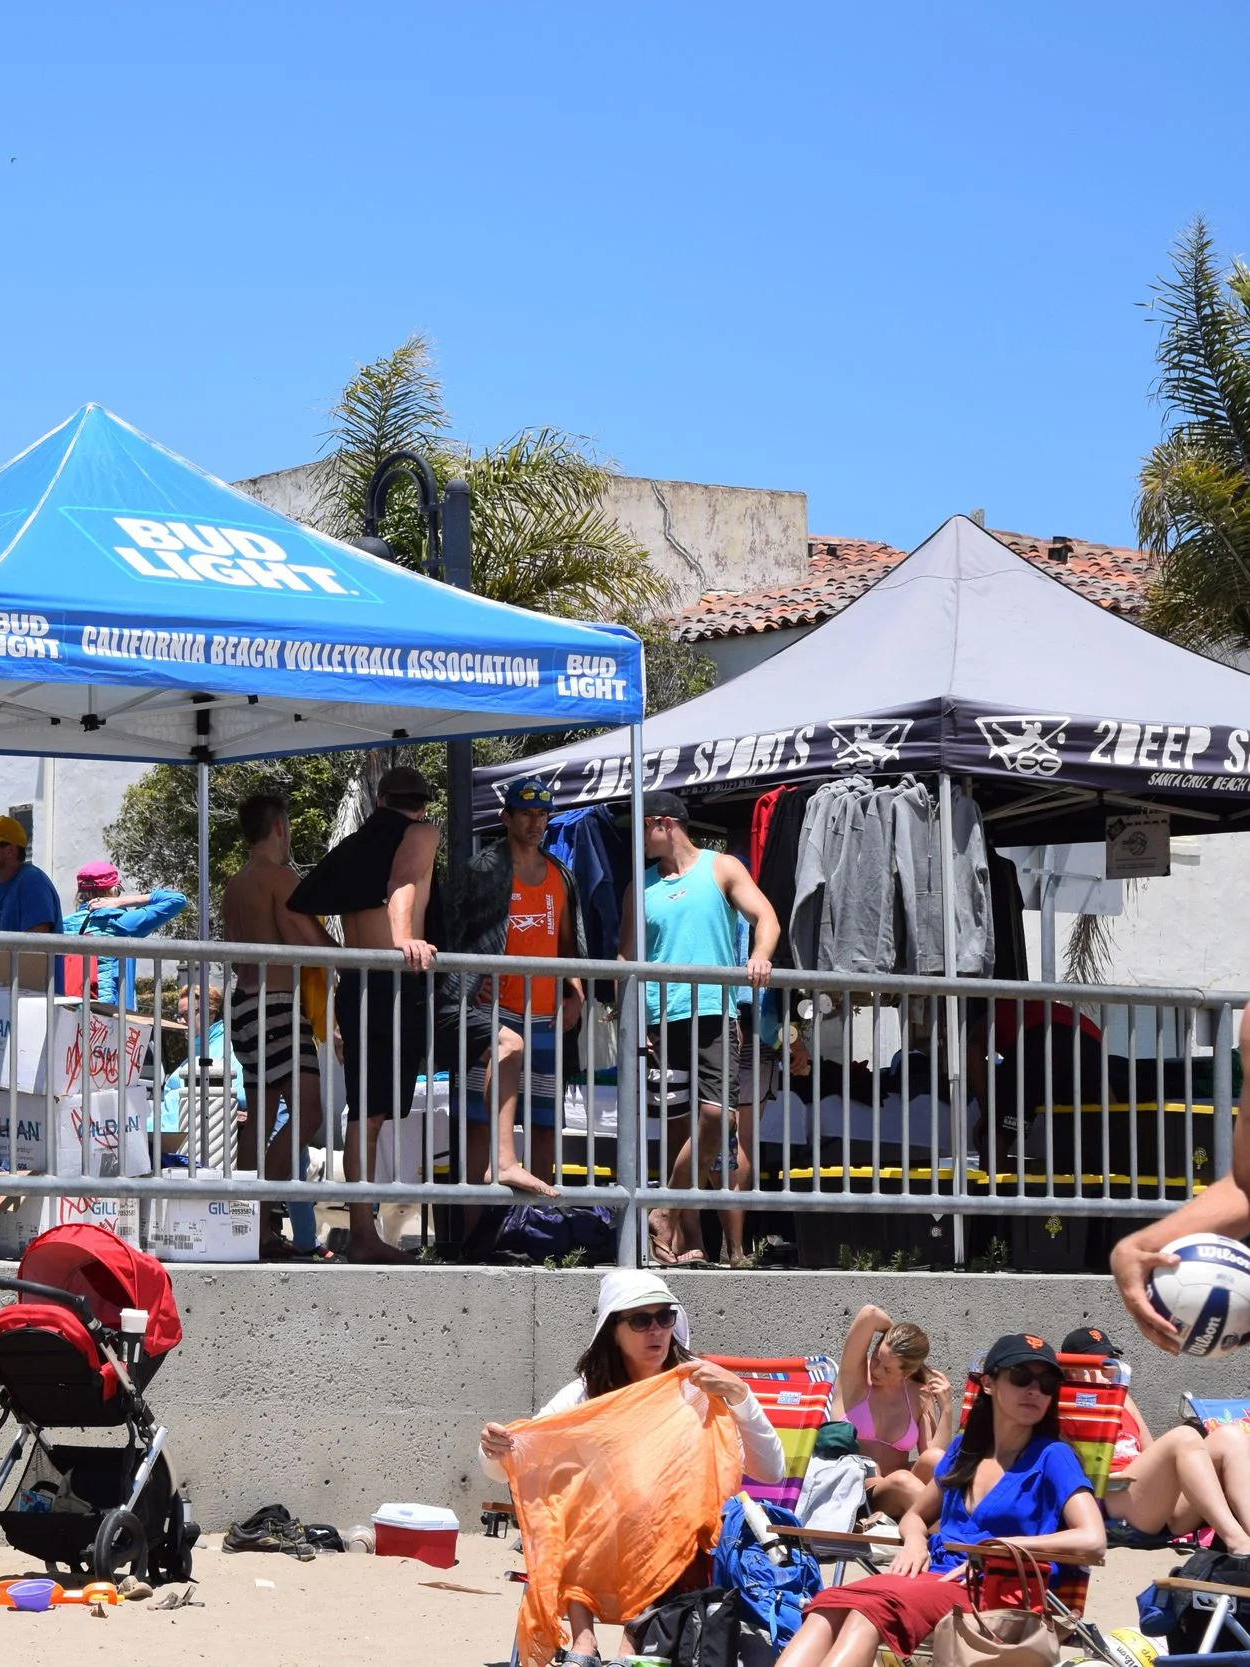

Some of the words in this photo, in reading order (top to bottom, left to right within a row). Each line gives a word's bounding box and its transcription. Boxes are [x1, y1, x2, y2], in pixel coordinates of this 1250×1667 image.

[113, 517, 287, 562] BUD
[113, 546, 351, 595] LIGHT
[81, 625, 206, 664] CALIFORNIA
[210, 635, 281, 669] BEACH
[284, 641, 401, 677] VOLLEYBALL
[407, 650, 539, 688] ASSOCIATION
[566, 654, 617, 678] BUD
[558, 675, 626, 701] LIGHT
[685, 724, 816, 785] SPORTS
[1088, 720, 1212, 770] 2DEEP
[1148, 772, 1183, 787] SANTA
[1181, 774, 1214, 789] CRUZ
[1213, 776, 1248, 792] BEACH
[1187, 1316, 1223, 1356] Wilson
